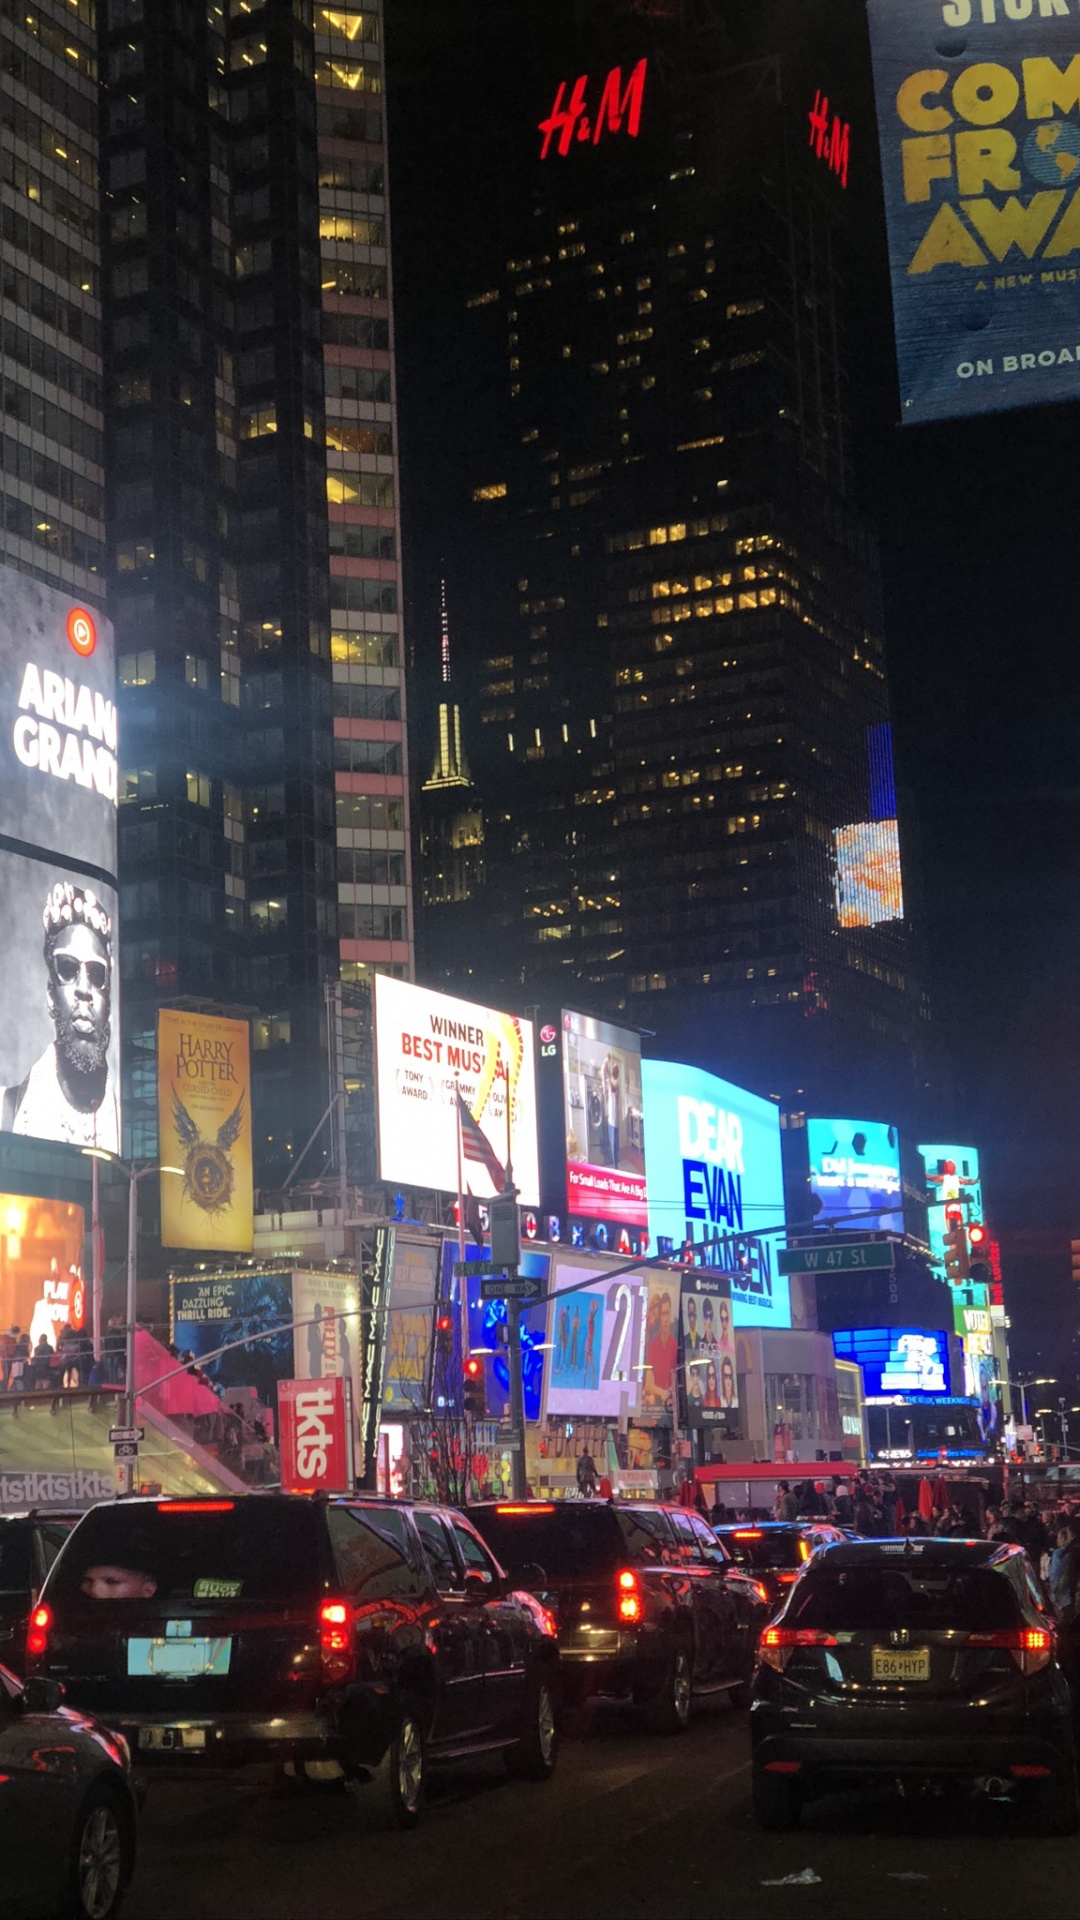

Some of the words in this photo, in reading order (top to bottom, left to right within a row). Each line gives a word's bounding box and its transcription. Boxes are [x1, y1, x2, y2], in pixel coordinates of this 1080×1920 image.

[537, 57, 647, 160] H&M
[809, 89, 849, 189] H&M
[974, 280, 988, 291] A
[994, 274, 1033, 289] NEW
[956, 359, 994, 379] ON
[18, 662, 117, 754] ARIAN
[430, 1014, 484, 1047] WINNER
[179, 1033, 235, 1062] HARRY
[402, 1032, 442, 1063] BEST
[541, 1045, 557, 1057] LG
[176, 1054, 238, 1084] POTTER
[404, 1070, 424, 1084] TONY
[445, 1079, 476, 1095] GRMMY
[183, 1084, 209, 1095] CURSED
[210, 1086, 233, 1098] CHILD
[402, 1085, 428, 1101] AWARD
[677, 1094, 745, 1174] DEAR
[569, 1171, 579, 1185] For
[579, 1173, 594, 1188] Small
[594, 1176, 609, 1191] Loads
[609, 1179, 620, 1193] That
[620, 1182, 630, 1195] Are
[682, 1158, 744, 1231] EVAN
[374, 1228, 385, 1283] MAC
[805, 1253, 818, 1268] W
[827, 1251, 843, 1267] 47
[851, 1249, 866, 1265] St
[43, 1280, 69, 1300] PLAY
[182, 1296, 224, 1309] DAZZLING
[488, 1284, 507, 1295] ONE
[513, 1283, 533, 1294] WAY
[177, 1309, 206, 1321] THRILL
[369, 1286, 380, 1340] MAC
[606, 1284, 648, 1383] 21
[364, 1344, 375, 1398] MAC
[296, 1387, 335, 1479] tkts
